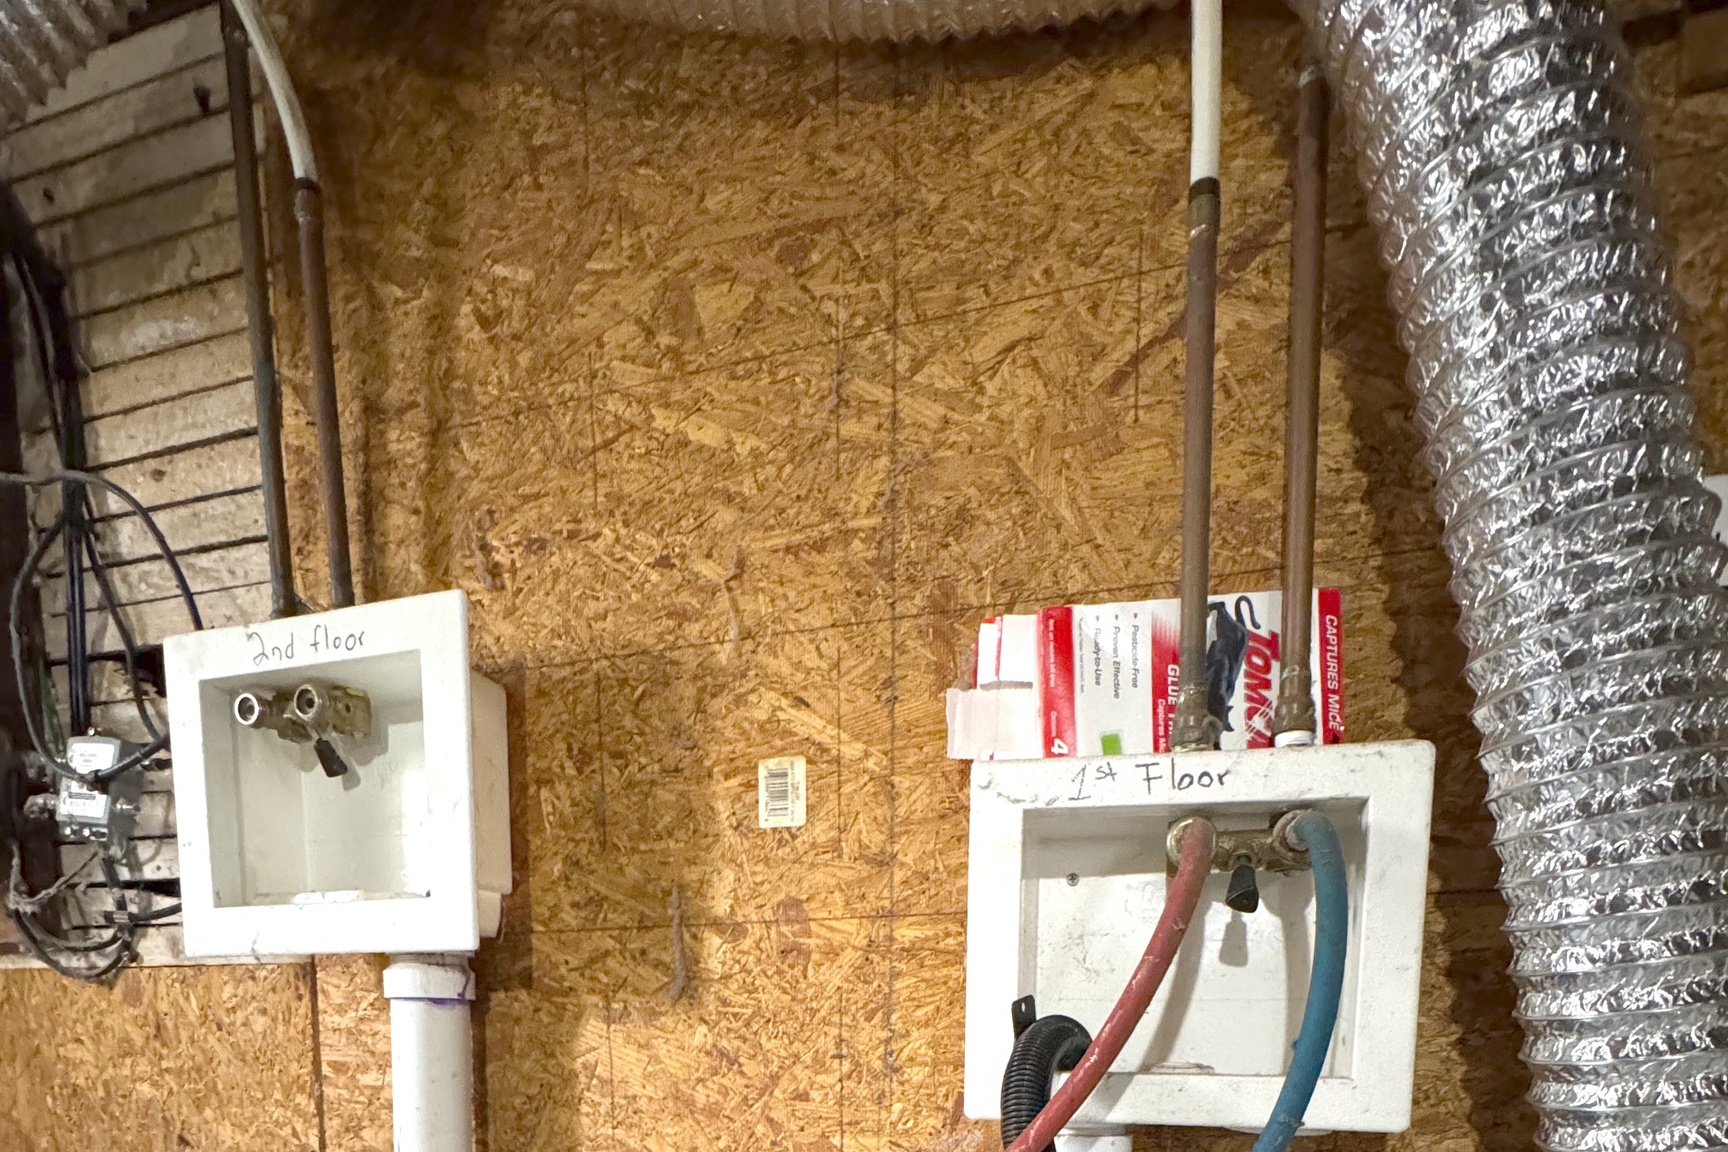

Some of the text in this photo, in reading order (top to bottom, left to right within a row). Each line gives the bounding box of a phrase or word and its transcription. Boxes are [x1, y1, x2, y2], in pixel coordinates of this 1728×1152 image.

[245, 624, 365, 666] 2nd floor
[1113, 661, 1121, 699] Effective
[1167, 664, 1179, 707] GLUE
[1325, 614, 1342, 731] CAPTURES MICE
[1158, 698, 1167, 737] Captures
[1051, 738, 1069, 755] 4
[1068, 757, 1230, 801] 1st Floor
